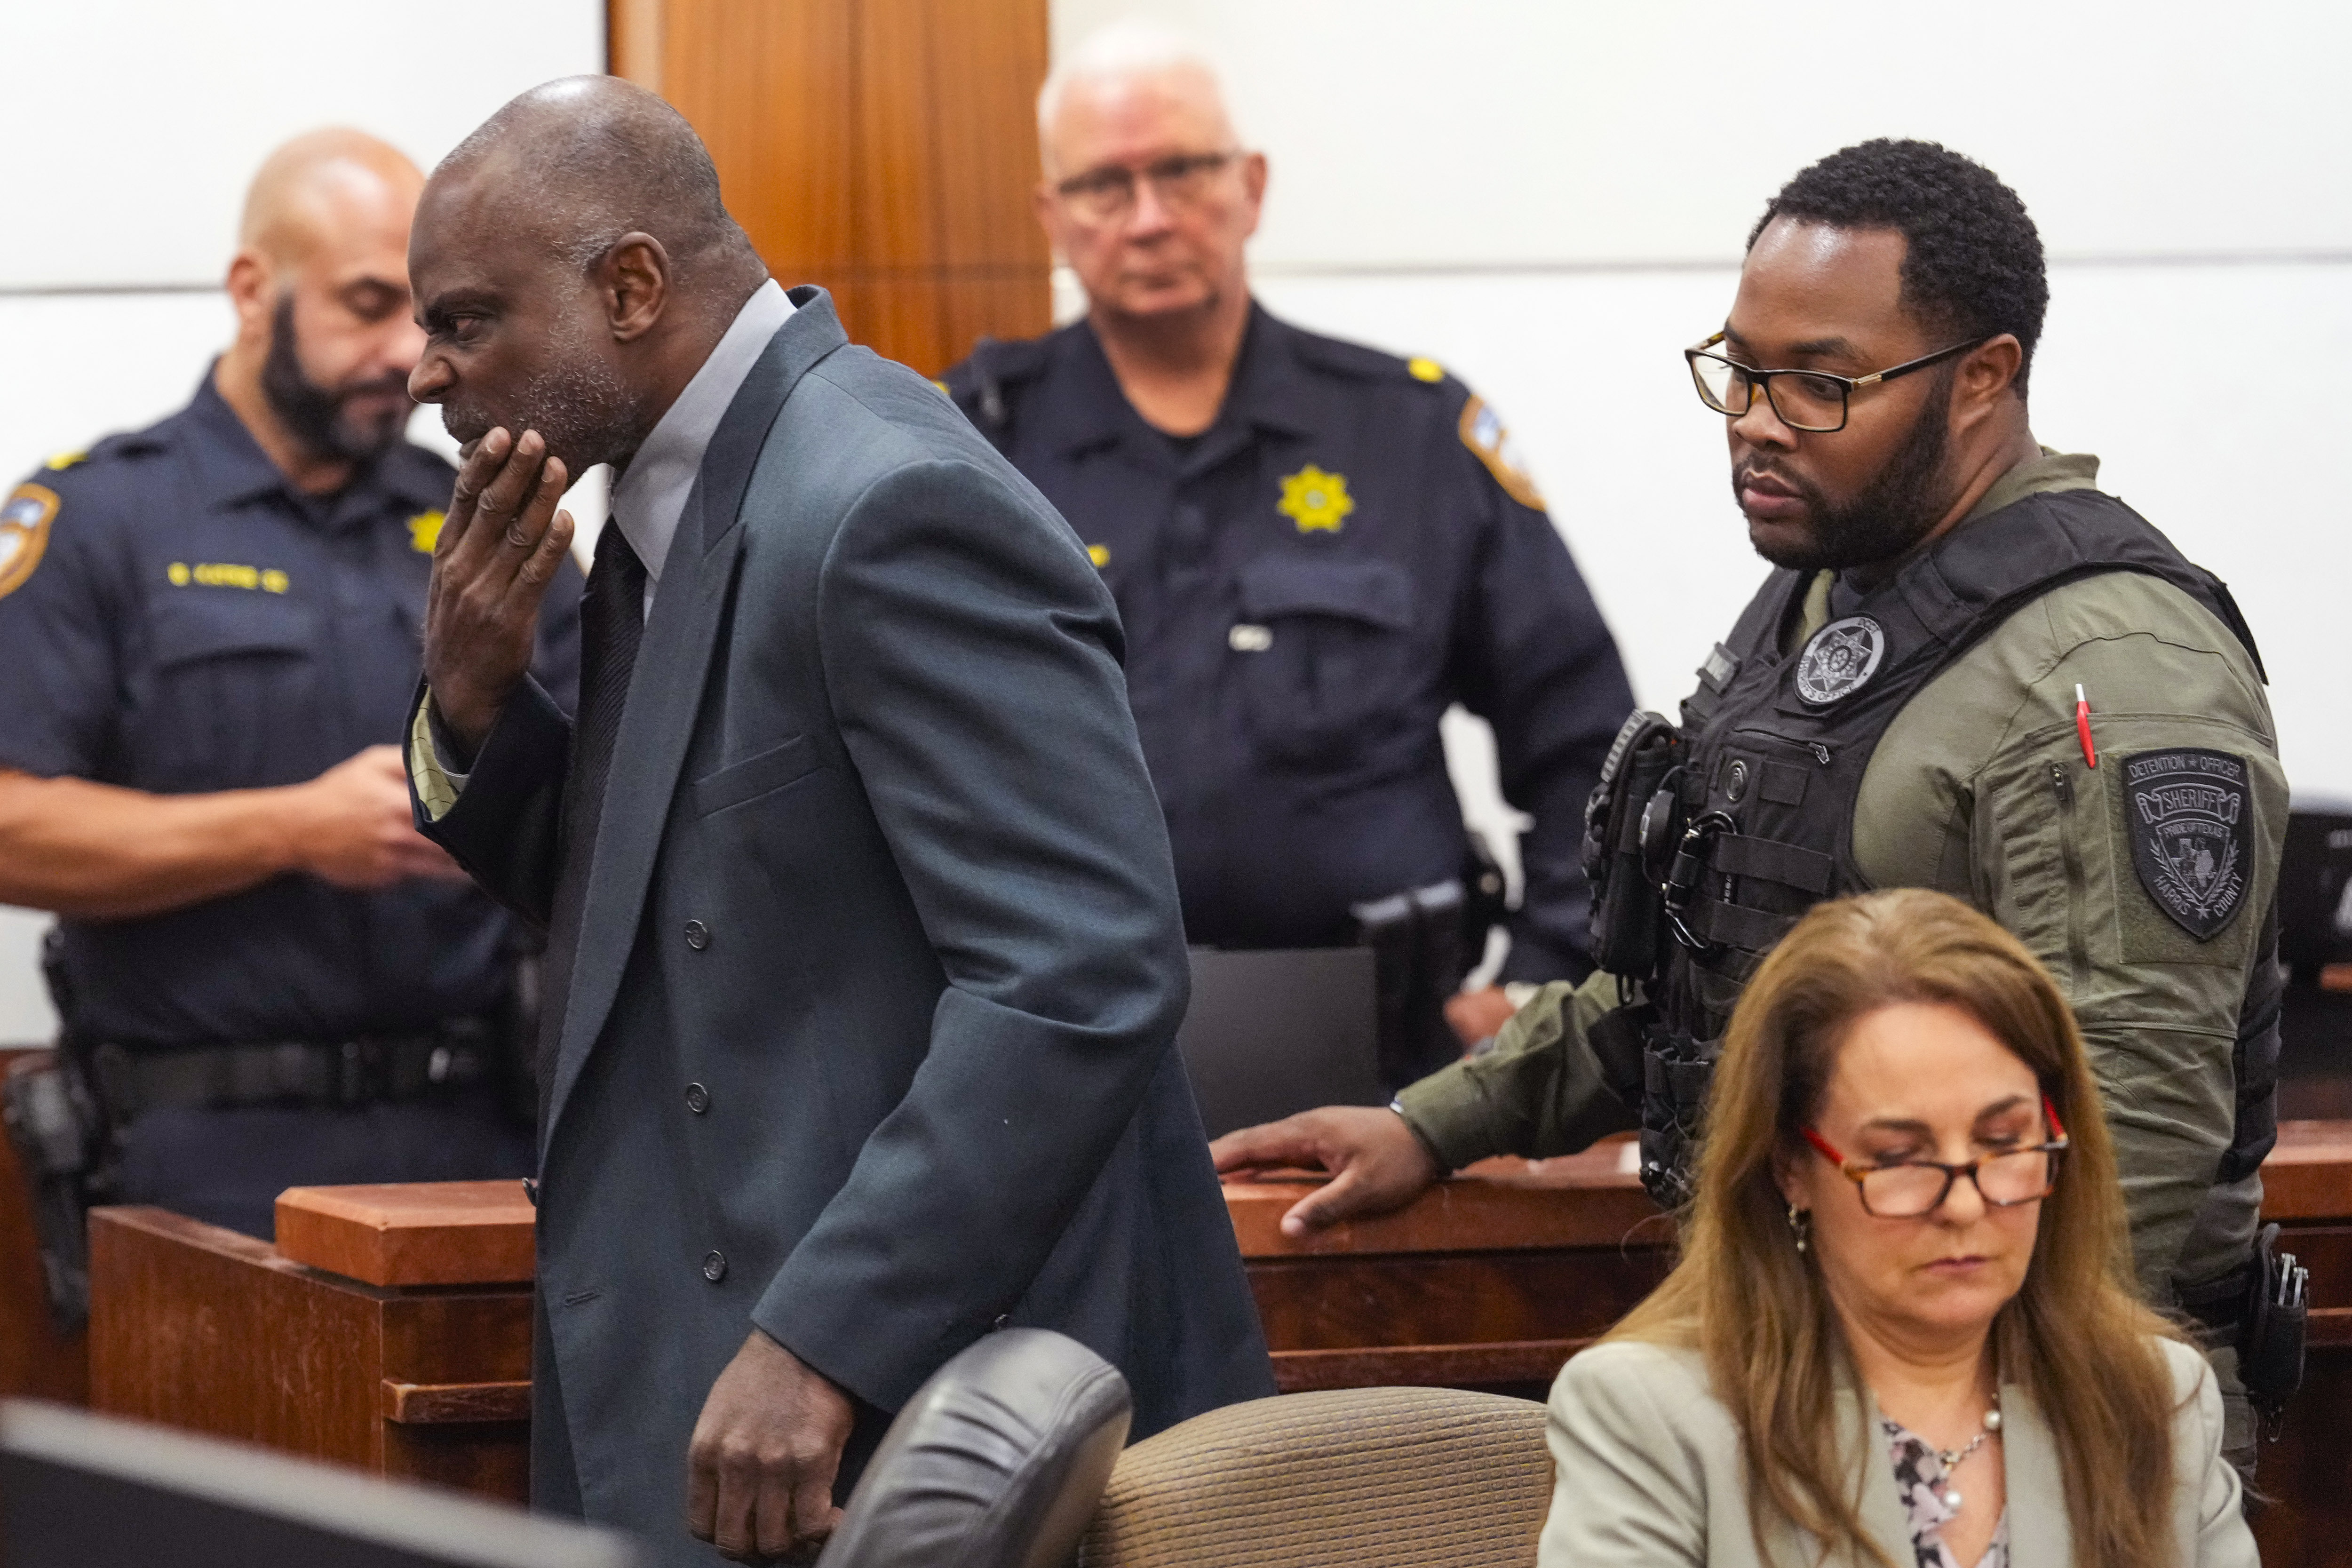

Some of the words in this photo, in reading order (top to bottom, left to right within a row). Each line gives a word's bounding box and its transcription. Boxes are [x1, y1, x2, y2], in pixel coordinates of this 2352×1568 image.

[2128, 756, 2185, 778] DETENTION
[2200, 756, 2241, 777] OFFICER
[2162, 789, 2218, 810] SHERIFF
[2163, 823, 2187, 838] PRIDE
[2154, 876, 2191, 915] HARRIS
[2214, 872, 2243, 917] COUNTY
